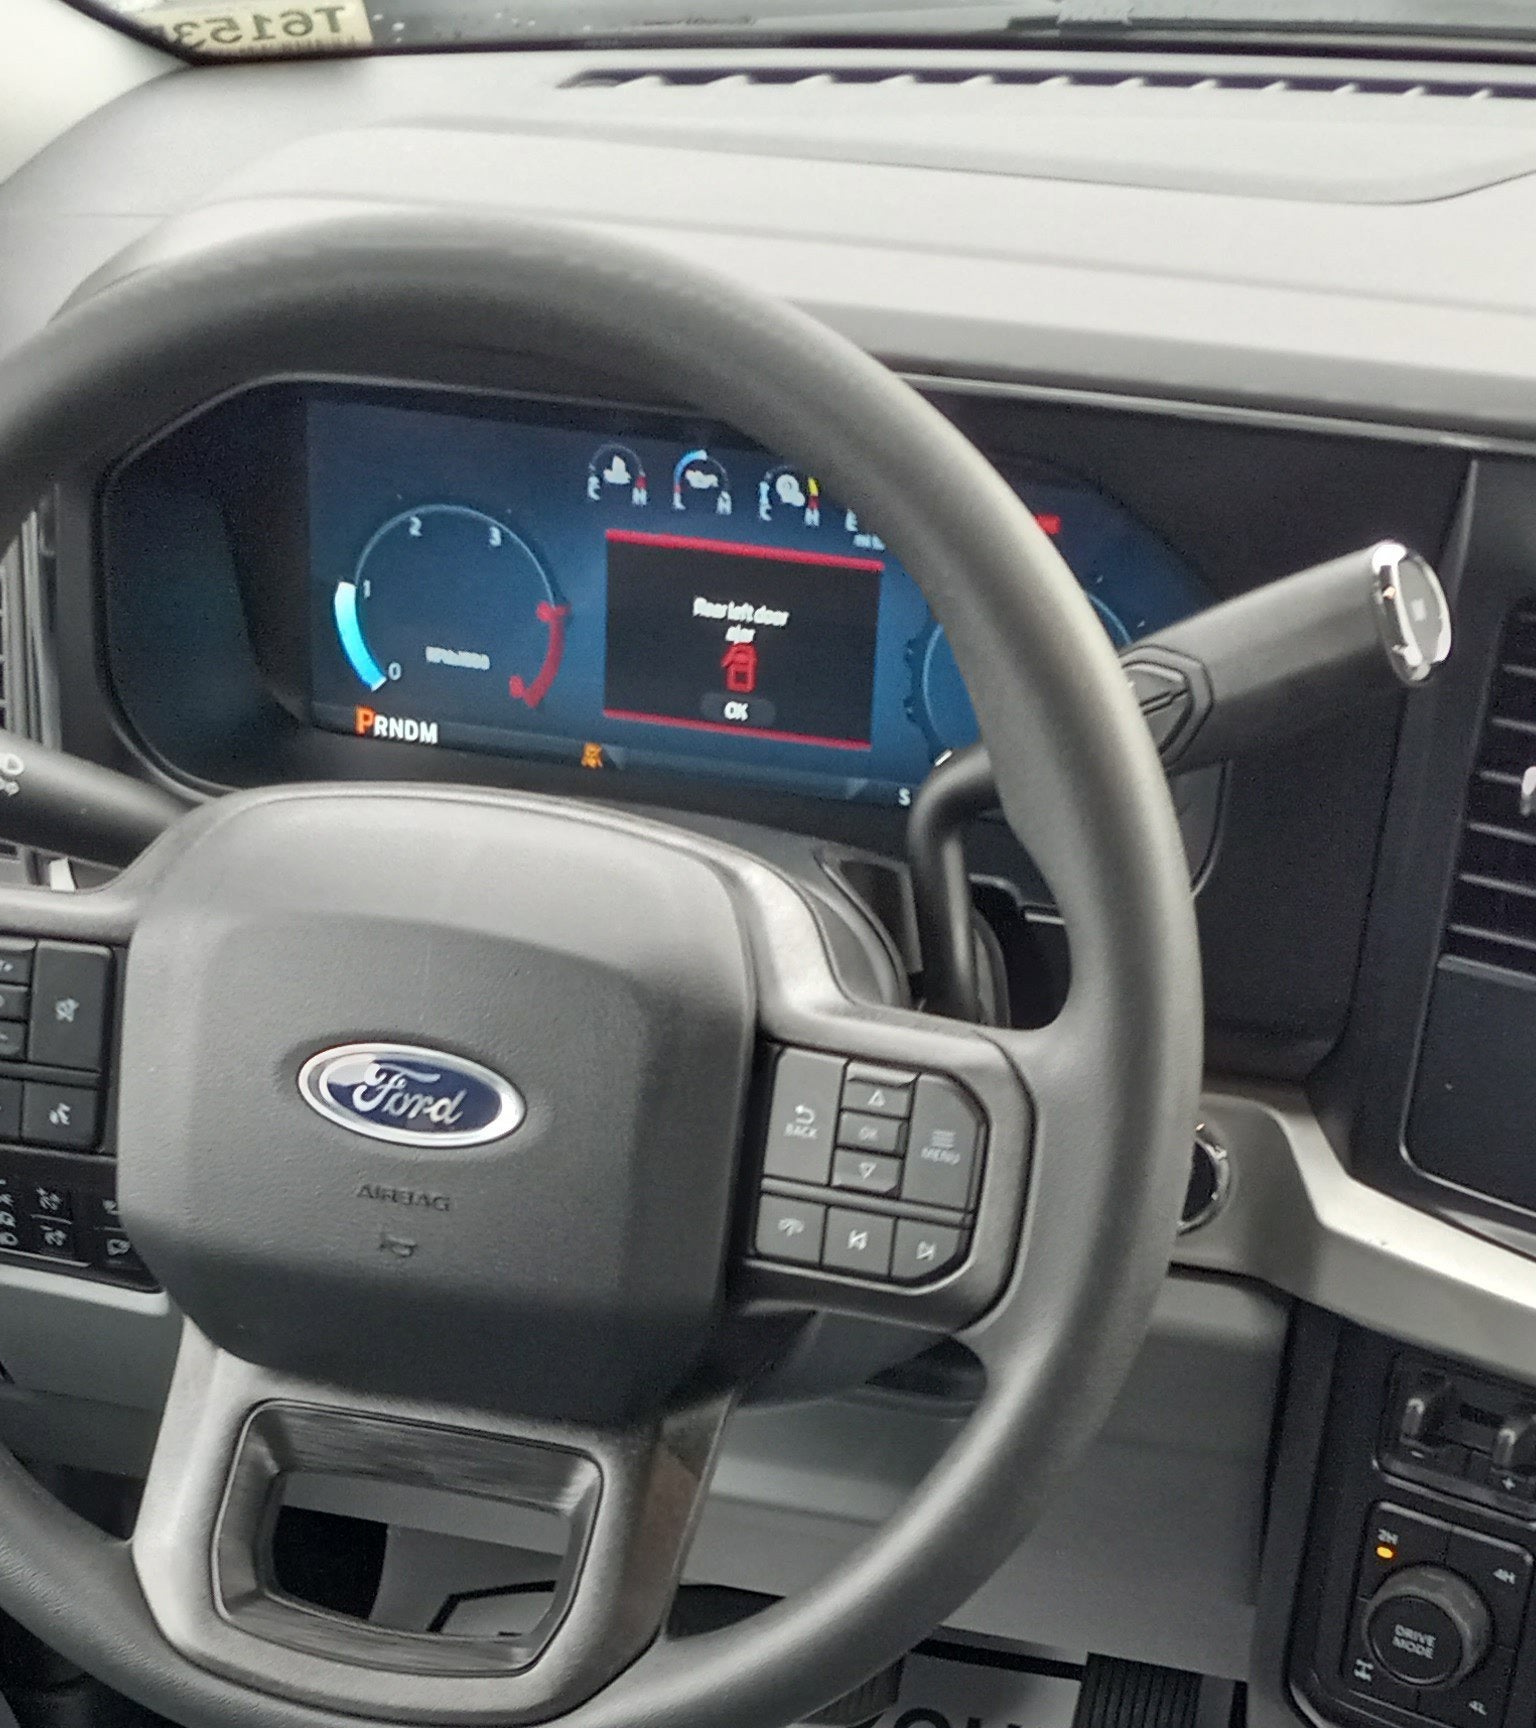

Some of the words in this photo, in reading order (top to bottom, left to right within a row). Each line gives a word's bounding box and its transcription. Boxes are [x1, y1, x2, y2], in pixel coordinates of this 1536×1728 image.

[408, 516, 423, 537] 2
[724, 702, 749, 721] OK
[352, 1060, 468, 1125] Ford
[1394, 1623, 1437, 1647] DRIVE
